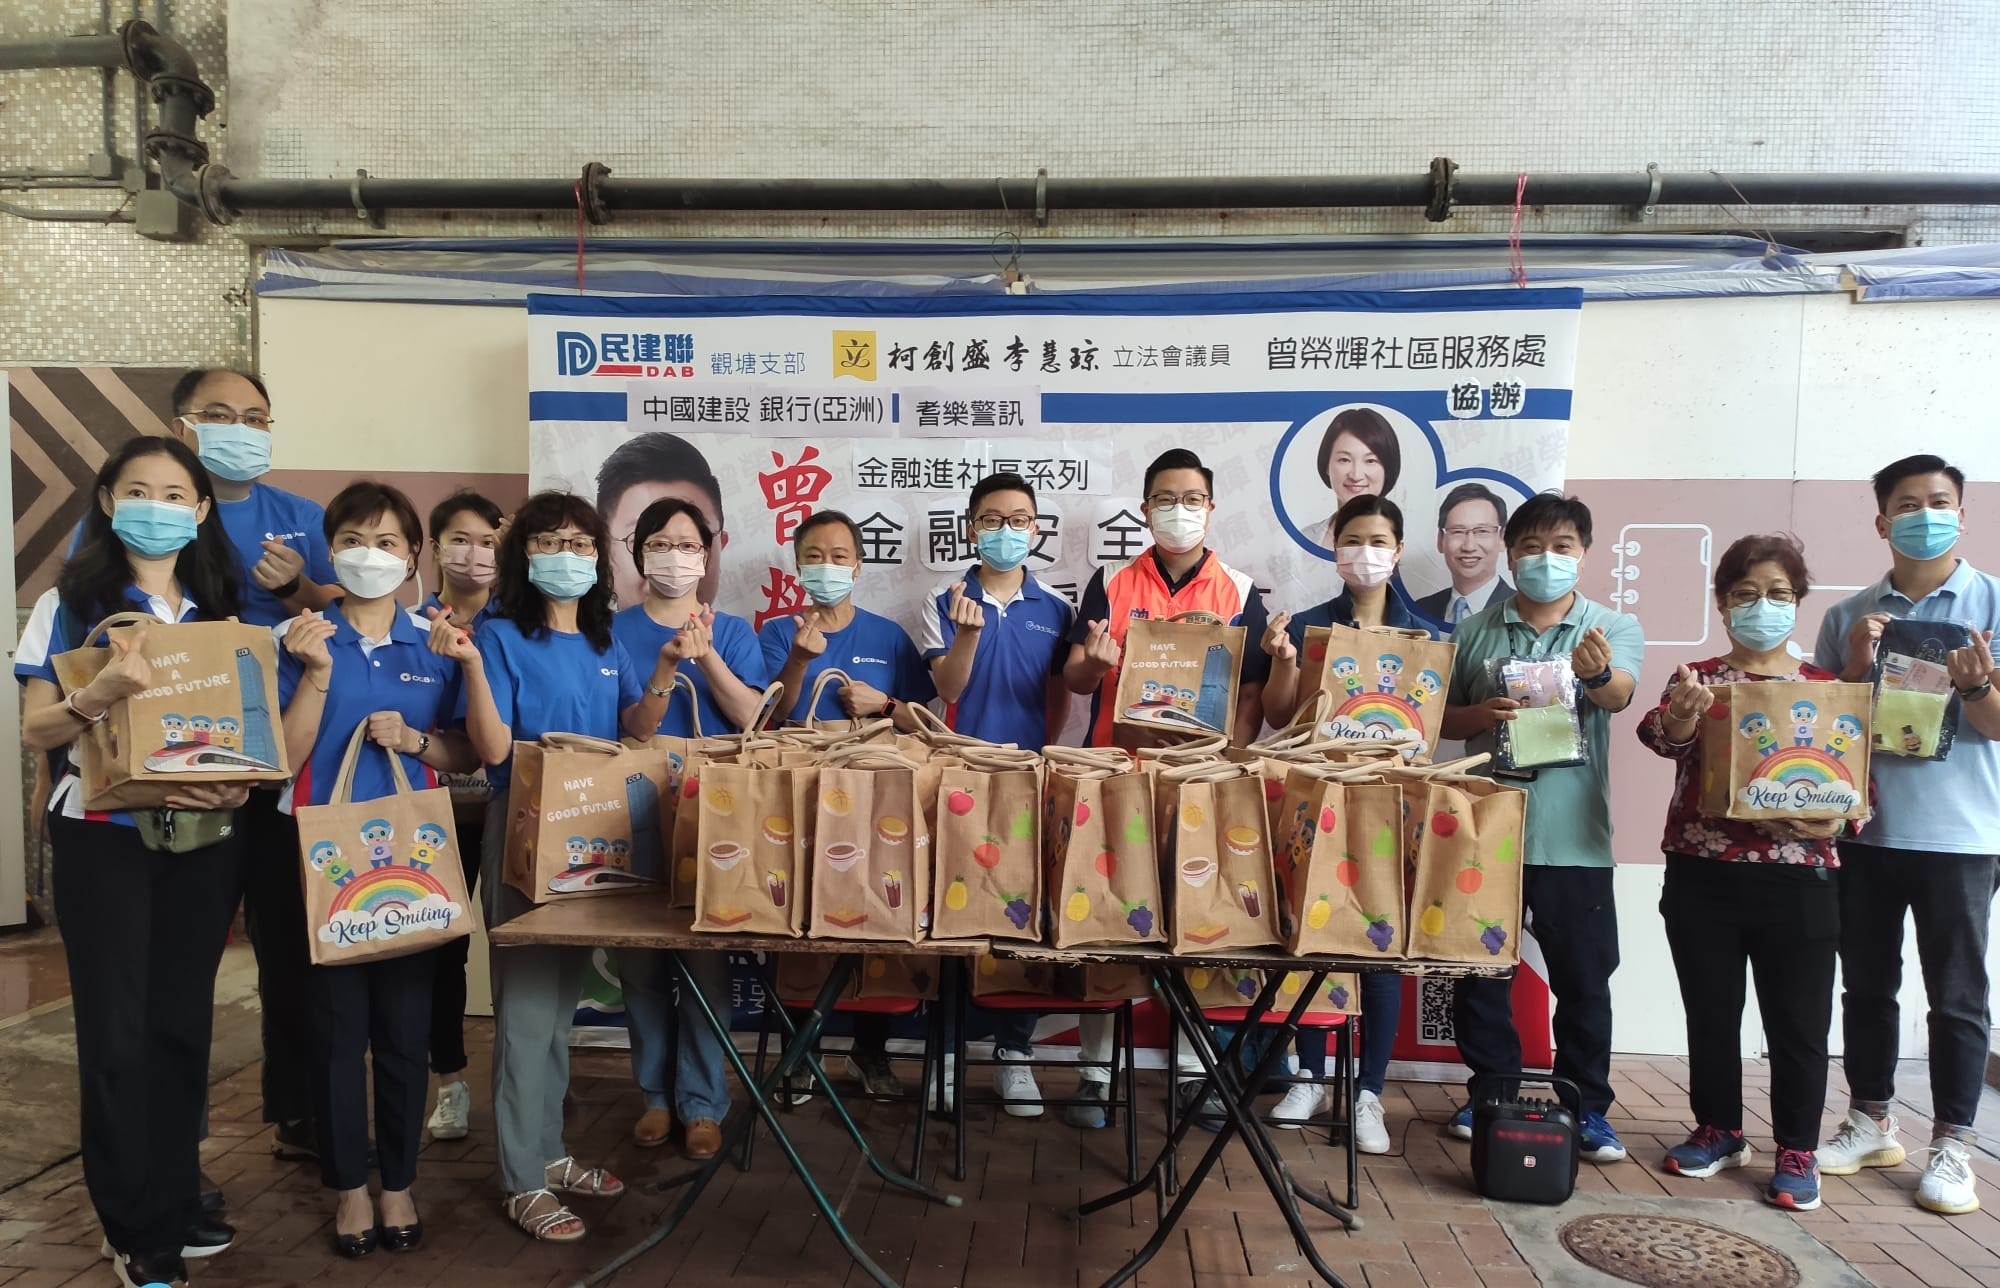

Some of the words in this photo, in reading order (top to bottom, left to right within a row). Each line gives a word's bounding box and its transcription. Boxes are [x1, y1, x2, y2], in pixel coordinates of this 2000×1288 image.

[600, 333, 694, 363] 民建聯
[1112, 345, 1232, 369] 立法會議員
[1267, 334, 1547, 371] 曾榮輝社區服務處
[646, 366, 695, 378] DAB
[710, 352, 806, 375] 觀塘支部
[1451, 381, 1522, 411] 協辦
[643, 396, 750, 424] 中國建設
[760, 395, 883, 425] 銀行(亞洲)
[915, 400, 1024, 428] 耆樂警訊
[1150, 643, 1177, 651] HAVE
[151, 652, 191, 669] HAVE
[1160, 659, 1199, 669] FUTURE
[171, 669, 182, 680] A
[175, 673, 231, 694] FUTURE
[563, 777, 594, 792] HAVE
[579, 793, 588, 802] A
[1747, 785, 1788, 809] Keep
[1793, 786, 1856, 813] Smiling
[546, 807, 581, 822] GOOD
[581, 799, 622, 815] FUTURE
[329, 918, 379, 944] Keep
[384, 906, 453, 935] Smiling
